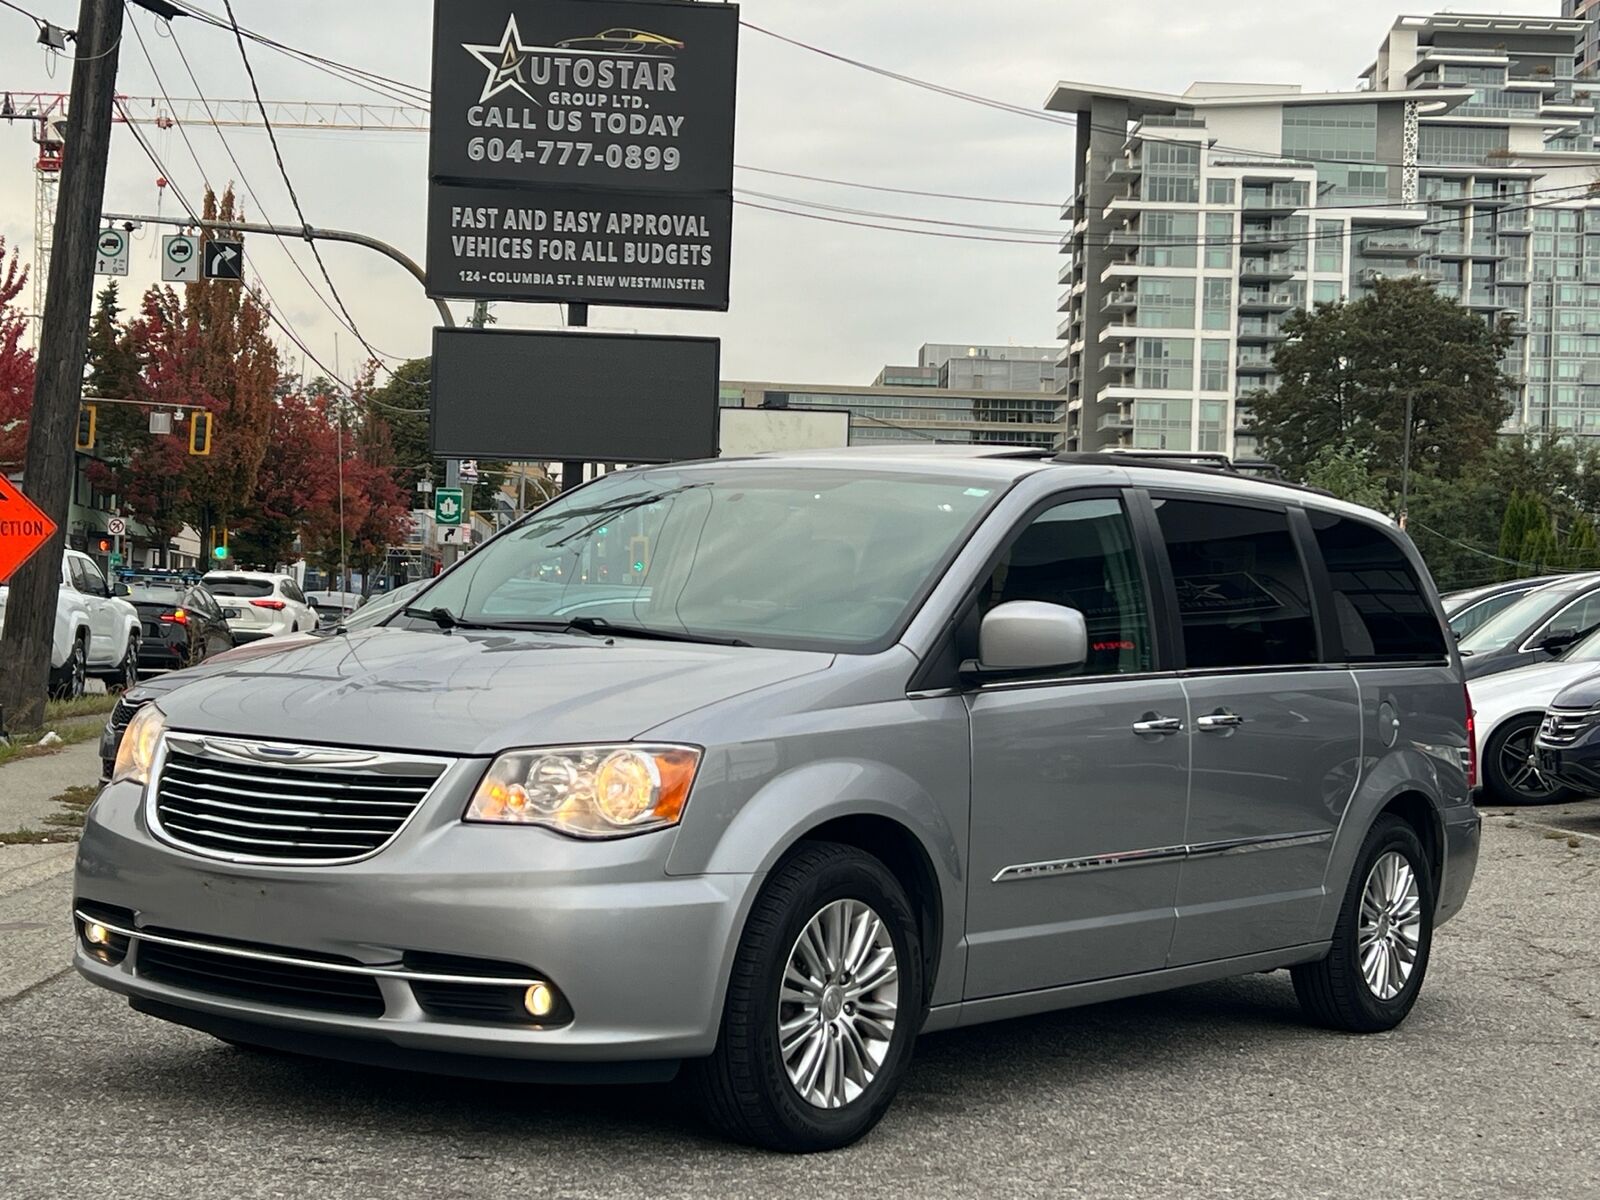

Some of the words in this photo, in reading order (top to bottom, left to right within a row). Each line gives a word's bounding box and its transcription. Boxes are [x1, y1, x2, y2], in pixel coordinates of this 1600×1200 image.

[549, 92, 607, 107] GROUP
[612, 95, 649, 109] LTD.
[467, 106, 536, 130] CALL
[547, 110, 582, 132] US
[591, 112, 684, 136] TODAY
[467, 137, 680, 171] 604-777-0899
[452, 207, 498, 230] FAST
[503, 209, 547, 231] AND
[553, 211, 602, 233] EASY
[606, 213, 709, 237] APPROVAL
[452, 235, 532, 259] VEHICES
[538, 239, 576, 260] FOR
[581, 241, 617, 263] ALL
[624, 243, 712, 266] BUDGETS
[587, 275, 615, 287] NEW
[618, 276, 706, 290] WESTMINSTER
[1, 521, 43, 536] CTION
